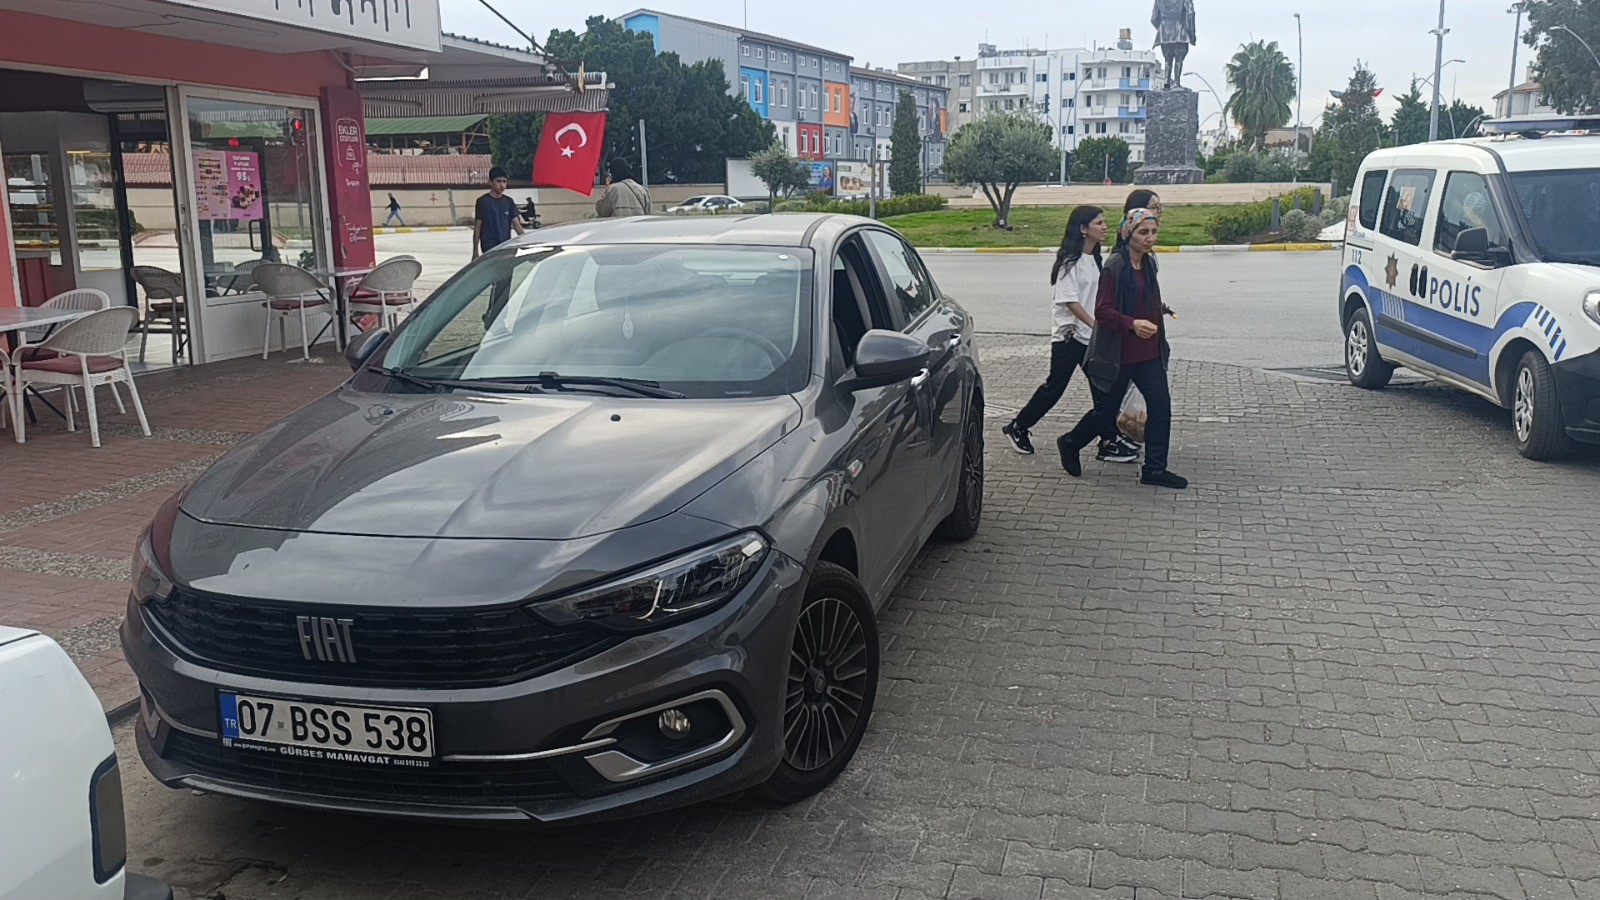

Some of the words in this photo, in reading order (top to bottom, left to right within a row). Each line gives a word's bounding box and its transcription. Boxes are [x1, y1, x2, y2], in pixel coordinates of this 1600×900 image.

[338, 125, 358, 135] EKLER
[1351, 248, 1362, 265] 112
[1430, 276, 1481, 317] POLİS
[296, 615, 357, 663] FIAT
[224, 718, 237, 729] TR
[238, 700, 274, 737] 07
[290, 706, 352, 746] BSS
[364, 713, 427, 752] 538
[280, 746, 323, 758] GÜRSES
[326, 752, 390, 765] MANAVGAT
